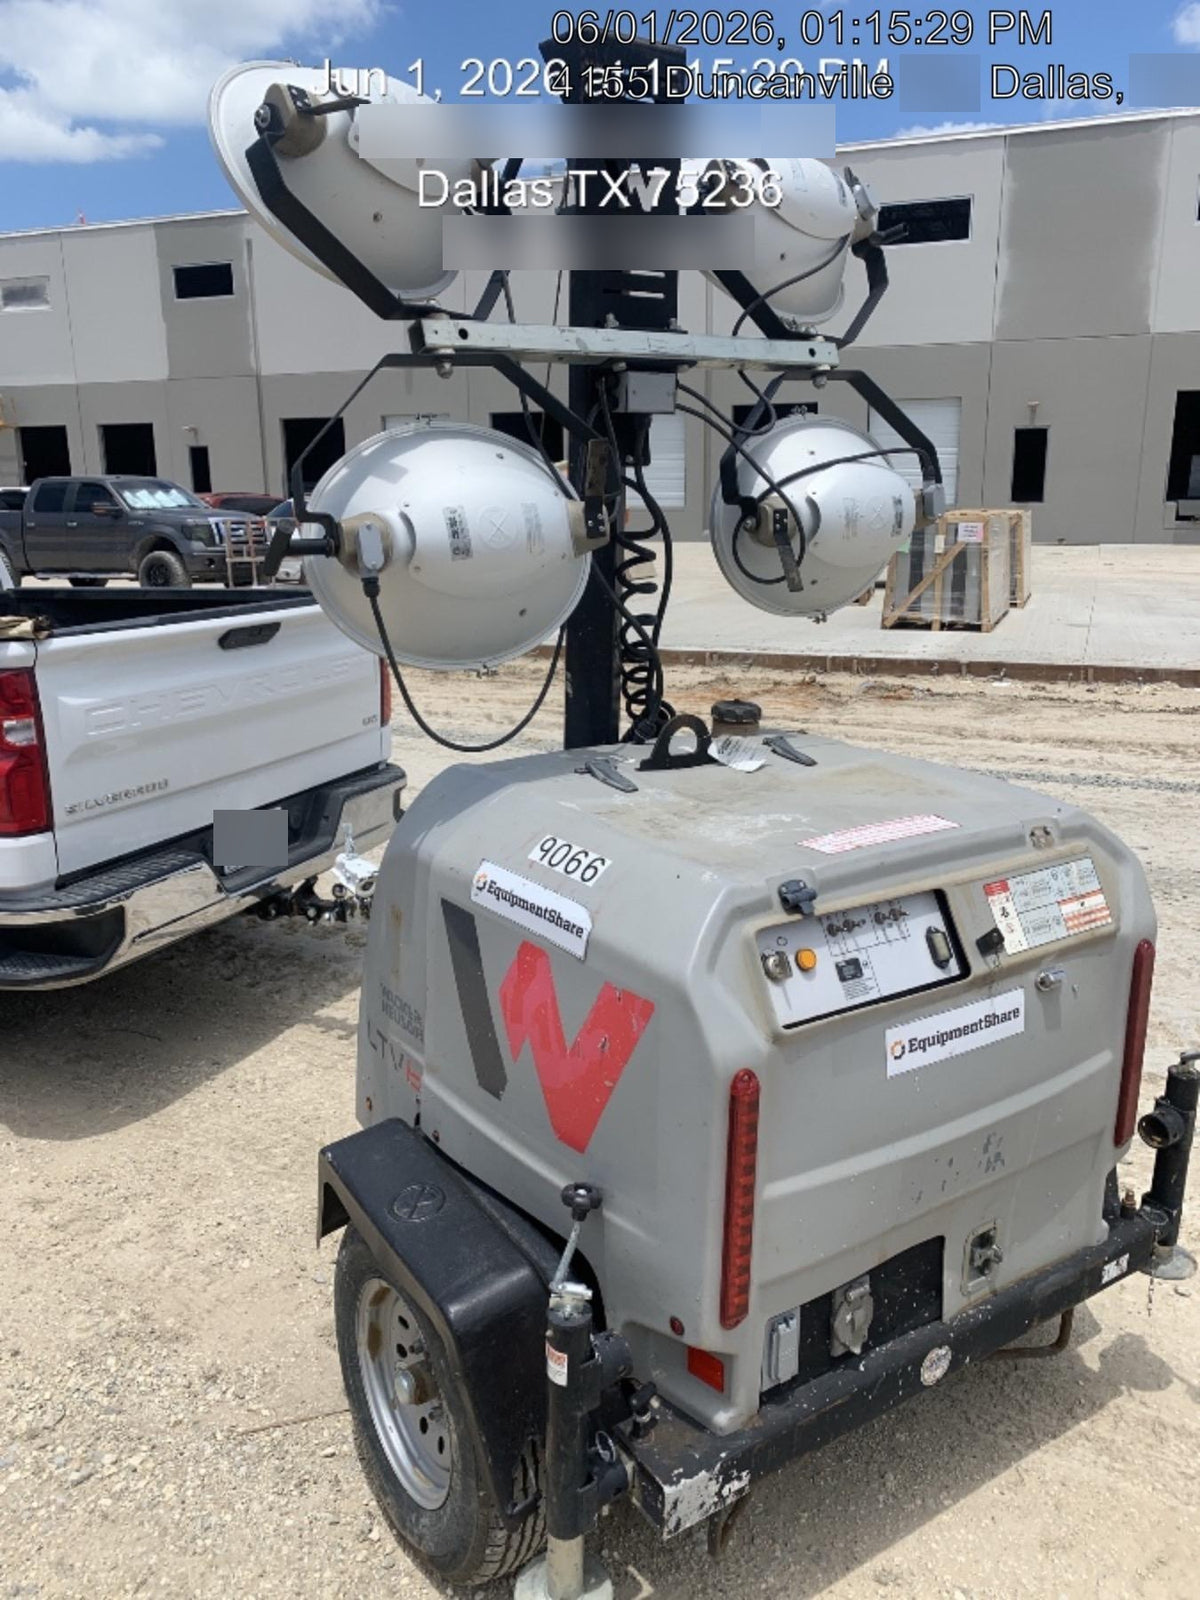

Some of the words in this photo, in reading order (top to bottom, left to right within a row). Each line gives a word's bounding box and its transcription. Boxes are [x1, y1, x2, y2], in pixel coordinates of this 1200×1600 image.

[84, 650, 372, 738] CHEVROLE
[537, 835, 606, 884] 9066
[485, 879, 585, 939] EquipmentShare
[906, 1005, 1021, 1055] EquipmentShare
